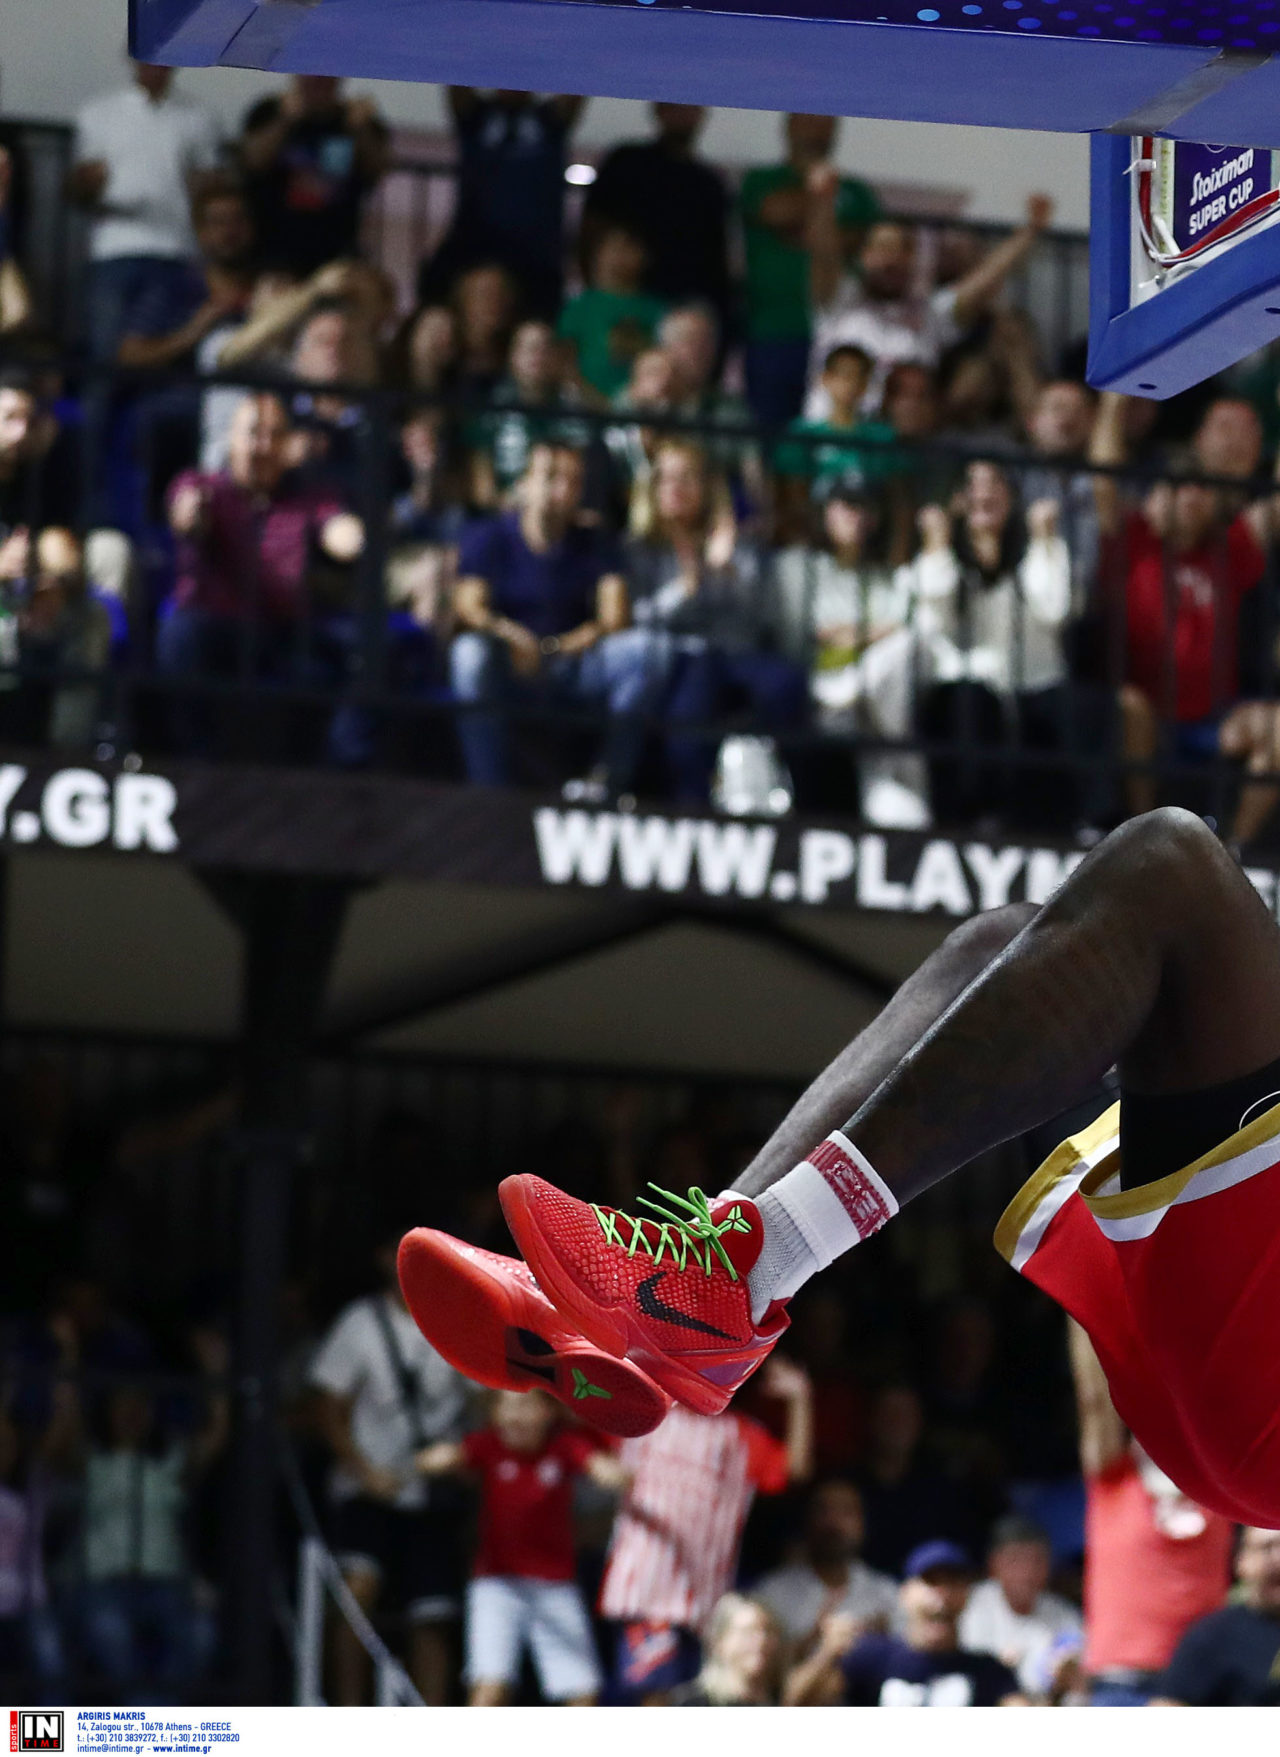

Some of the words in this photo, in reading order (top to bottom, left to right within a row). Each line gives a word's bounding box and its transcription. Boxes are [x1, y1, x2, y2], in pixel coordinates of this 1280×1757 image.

[1189, 148, 1254, 206] Stoiximan
[1189, 203, 1227, 235] SUPER
[1228, 178, 1254, 209] CUP
